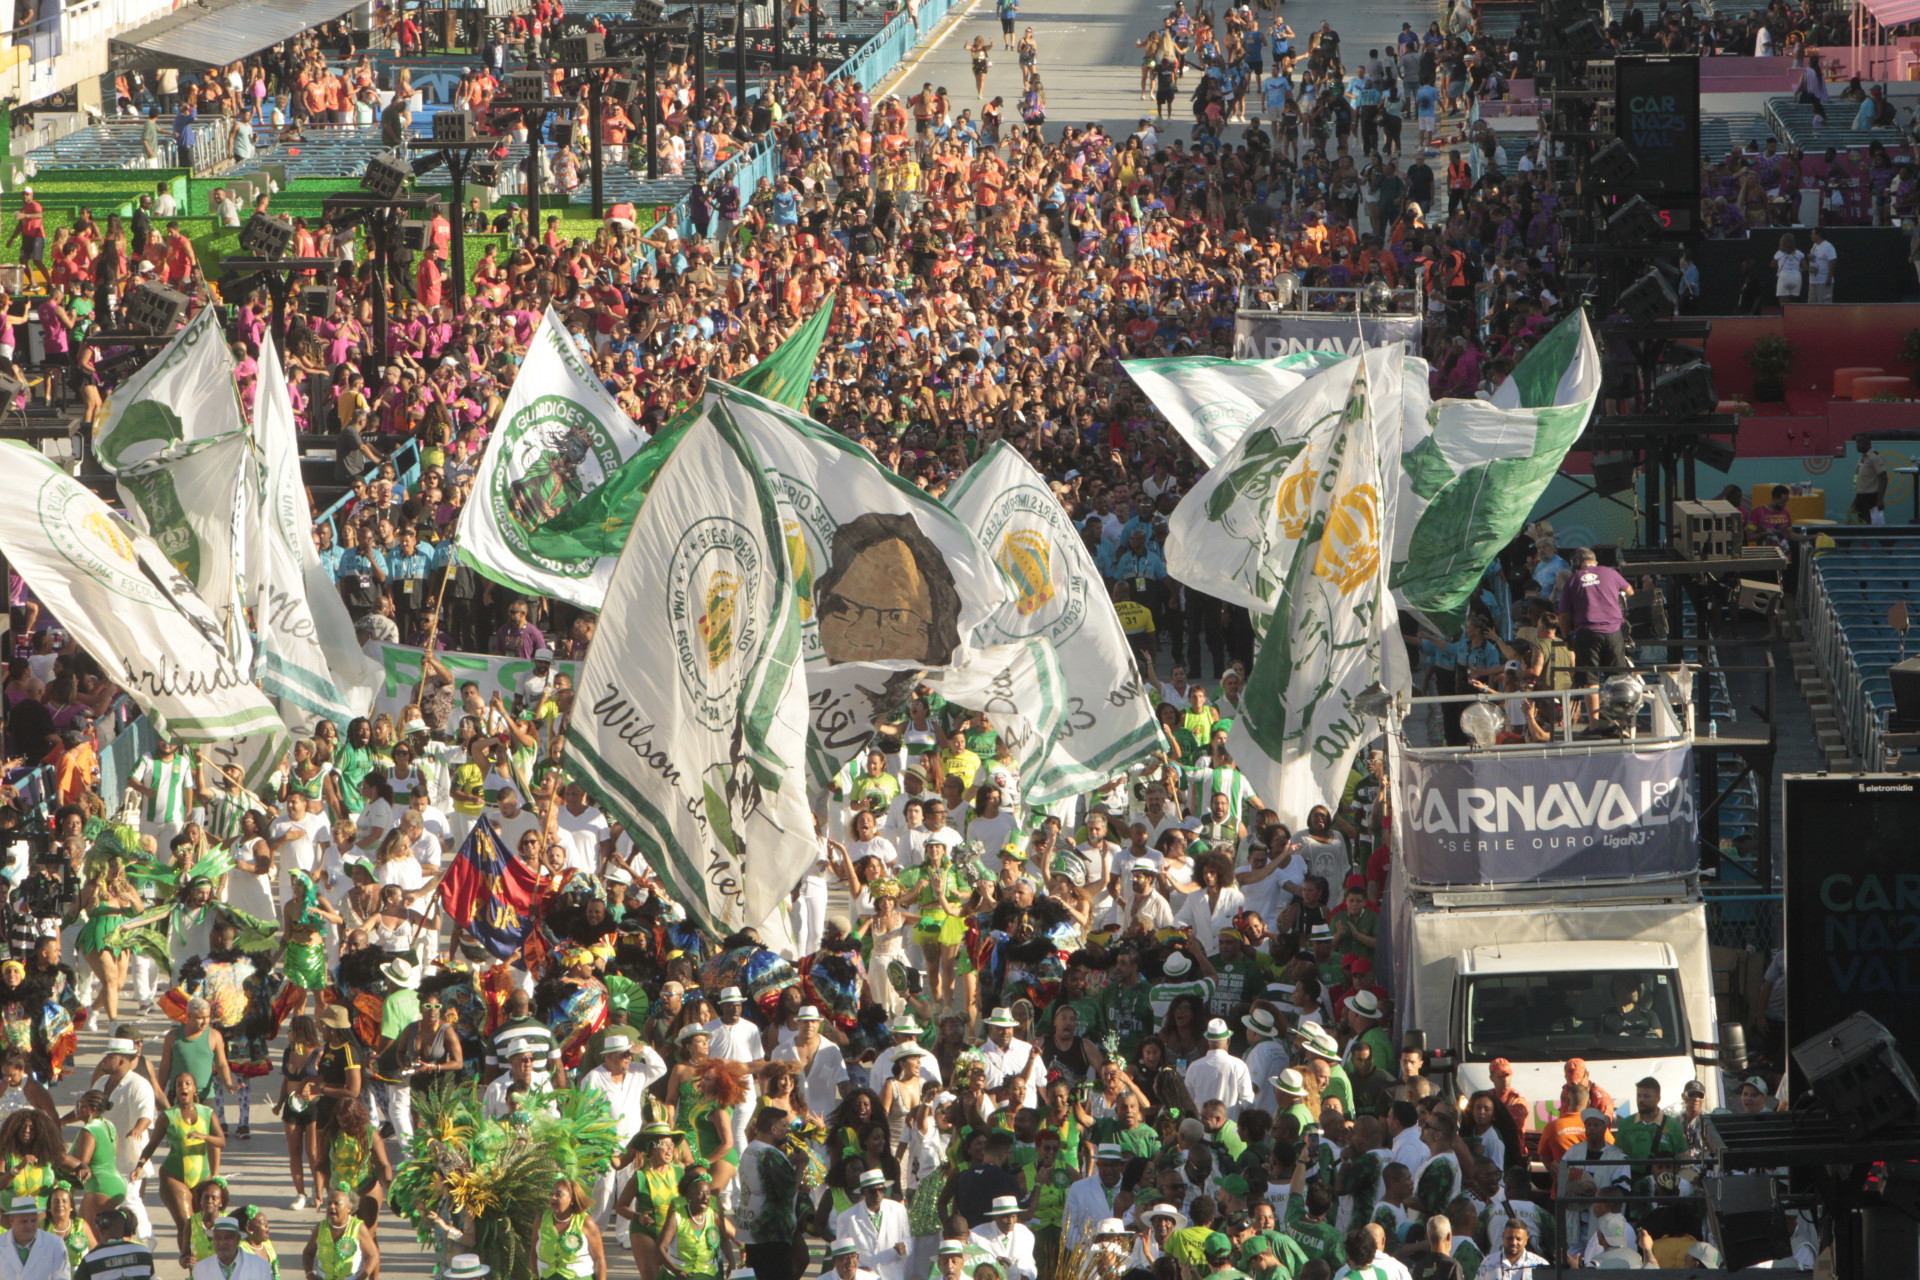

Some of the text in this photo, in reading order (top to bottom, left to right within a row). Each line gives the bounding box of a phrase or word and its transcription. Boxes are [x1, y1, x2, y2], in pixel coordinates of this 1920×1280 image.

[1630, 96, 1676, 112] CAR
[1634, 132, 1673, 147] VAL
[515, 400, 585, 431] GUARDIÕES
[586, 421, 606, 447] DO
[282, 494, 296, 527] UMA
[87, 558, 163, 600] UMA ESCOLA
[673, 590, 685, 620] UMA
[1125, 616, 1138, 625] 31
[593, 682, 682, 787] Wilson
[1407, 779, 1671, 835] CARNAVAL
[1447, 831, 1646, 852] SÉRIE OURO LigaRJ
[469, 897, 520, 930] RUA
